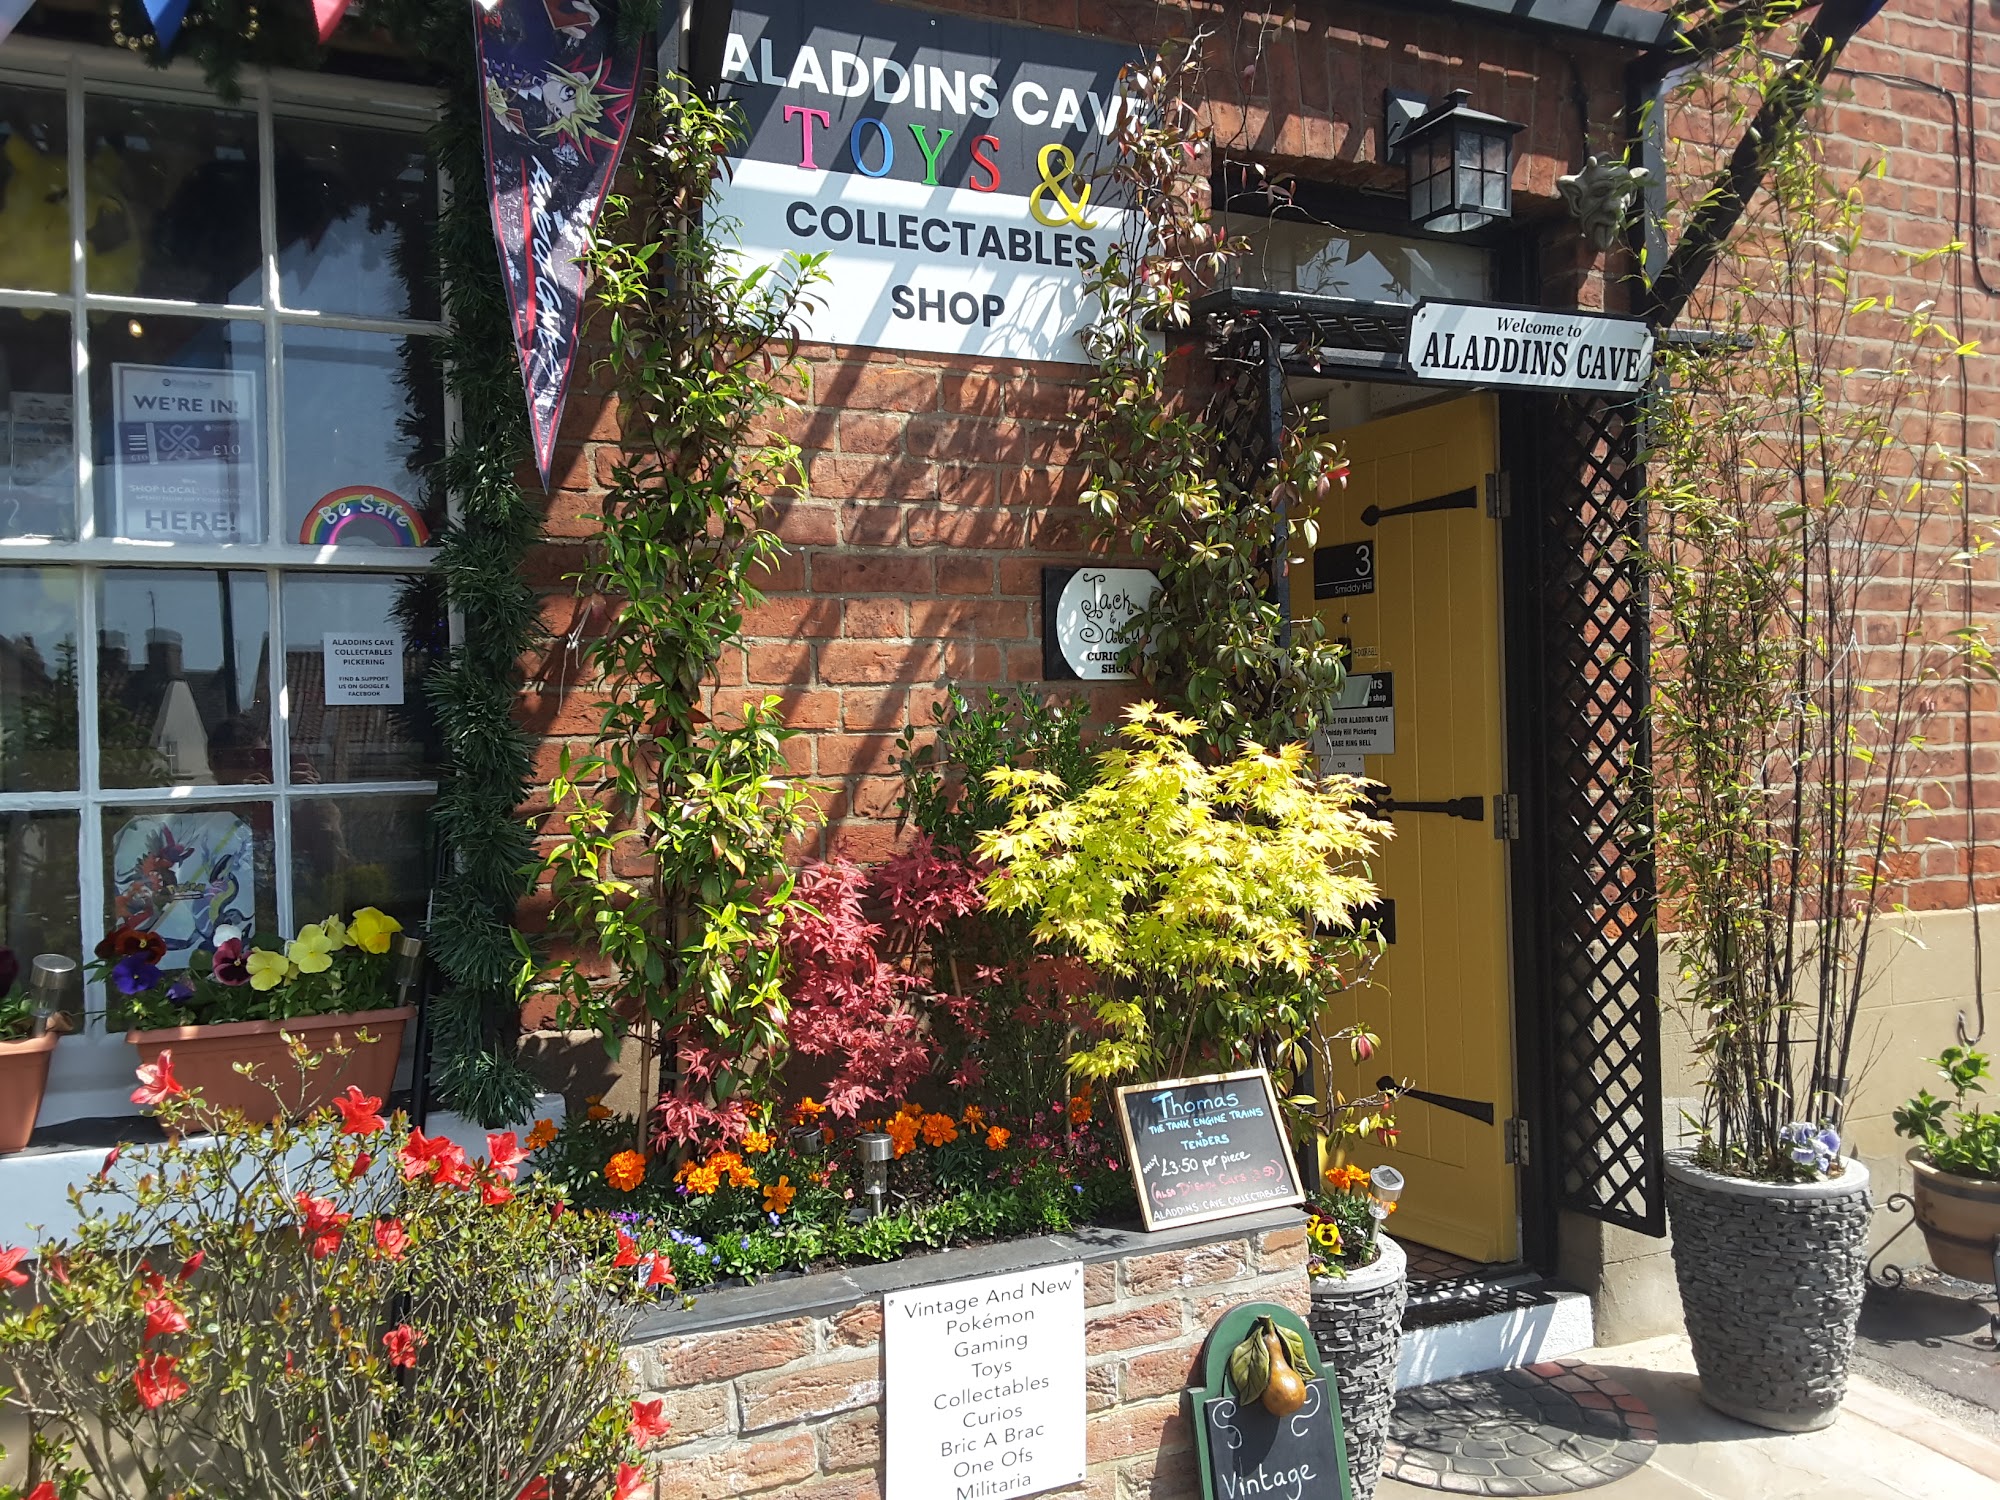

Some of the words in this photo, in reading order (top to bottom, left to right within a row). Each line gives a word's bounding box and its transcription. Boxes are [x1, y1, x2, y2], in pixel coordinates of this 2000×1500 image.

[721, 32, 1000, 119] ALADDINS
[1012, 81, 1149, 138] CAVE
[783, 104, 1001, 193] TOYS
[1029, 144, 1098, 230] &
[786, 201, 1098, 269] COLLECTABLES
[892, 284, 1005, 328] SHOP
[1496, 316, 1564, 337] Welcome
[1568, 322, 1582, 338] to
[1420, 331, 1569, 377] ALADDINS
[1576, 344, 1641, 383] CAVE
[133, 394, 204, 412] WE'RE
[210, 398, 239, 414] IN!
[212, 444, 241, 456] £10
[128, 484, 159, 493] SHOP
[162, 485, 198, 494] LOCAL
[145, 509, 236, 532] HERE!
[318, 502, 351, 525] Be
[360, 494, 411, 527] Safe
[1355, 544, 1371, 577] 3
[1082, 573, 1134, 619] Jack
[1334, 582, 1361, 594] Smiddy
[1362, 581, 1373, 590] Hill
[343, 658, 385, 666] PICKERING
[1349, 716, 1374, 724] ALADDINS
[1374, 715, 1389, 723] CAVE
[1353, 727, 1377, 736] Pickering
[1359, 739, 1372, 747] BELL
[1151, 1090, 1239, 1119] Thomas
[1148, 1124, 1165, 1135] THE
[1166, 1120, 1192, 1131] TANK
[1193, 1113, 1228, 1127] ENGINE
[1229, 1107, 1264, 1120] TRAINS
[1180, 1133, 1230, 1151] TENDERS
[1142, 1154, 1161, 1174] ONLY
[1202, 1155, 1219, 1176] per
[1220, 1151, 1251, 1171] piece
[1218, 1173, 1247, 1185] Cars
[1152, 1202, 1200, 1222] ALADDINS
[1202, 1197, 1226, 1210] CAVE
[1228, 1184, 1289, 1206] COLLECTABLES
[904, 1296, 979, 1320] Vintage
[985, 1283, 1024, 1306] And
[1031, 1279, 1072, 1297] New
[946, 1308, 1035, 1336] Pokémon
[954, 1334, 1029, 1358] Gaming
[971, 1361, 1013, 1380] Toys
[933, 1375, 1050, 1411] Collectables
[962, 1405, 1023, 1428] Curios
[941, 1437, 977, 1457] Bric
[983, 1432, 998, 1449] A
[1004, 1424, 1045, 1443] Brac
[953, 1458, 994, 1479] One
[1001, 1447, 1034, 1467] Ofs
[956, 1472, 1032, 1500] Militaria
[1221, 1462, 1317, 1500] Vintage
